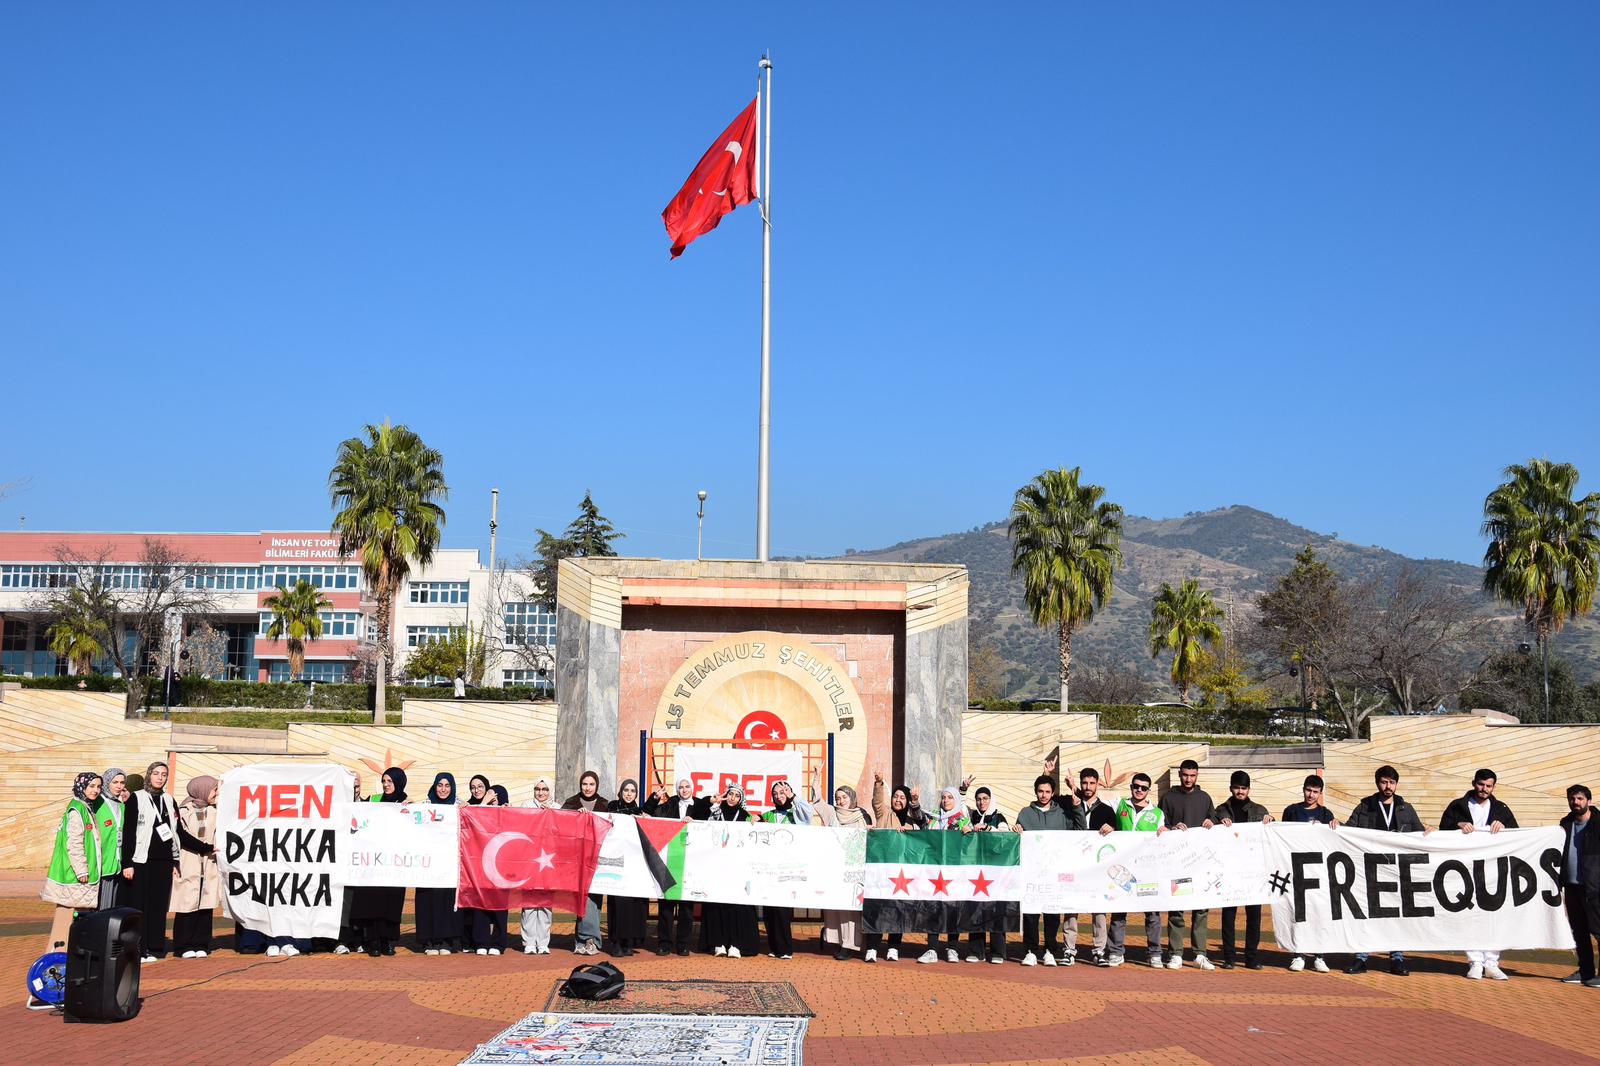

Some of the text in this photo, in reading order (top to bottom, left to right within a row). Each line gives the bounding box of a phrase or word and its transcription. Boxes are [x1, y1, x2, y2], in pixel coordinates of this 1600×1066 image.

[265, 548, 357, 558] BİLİMLERİ FAKÜLESİ
[271, 537, 346, 547] İNSAN VE TOPL
[665, 642, 855, 732] 15 TEMMUZ ŞEHİTLER
[238, 784, 333, 820] MEN
[226, 828, 336, 864] DAKKA
[229, 872, 332, 907] DUKKA
[1268, 847, 1563, 923] #FREEQUDS
